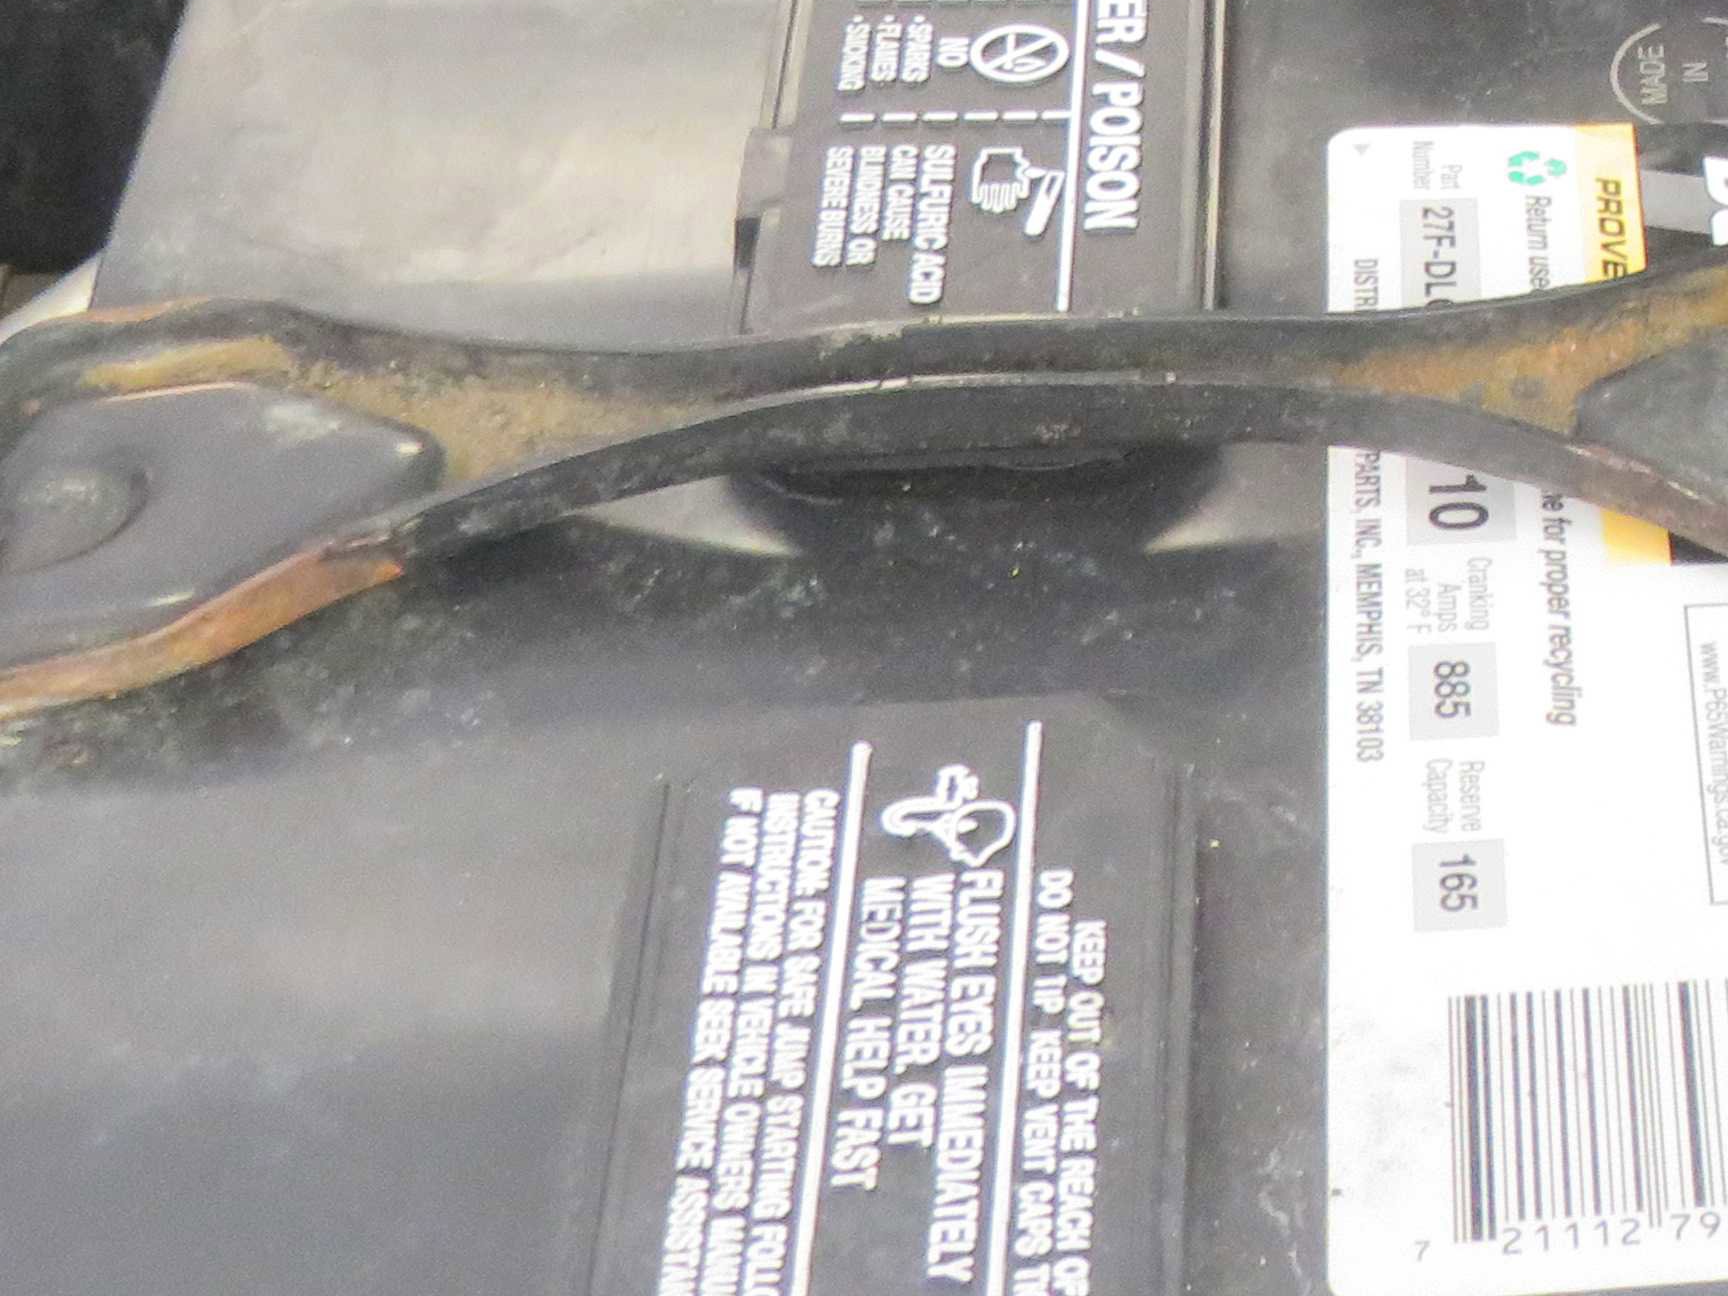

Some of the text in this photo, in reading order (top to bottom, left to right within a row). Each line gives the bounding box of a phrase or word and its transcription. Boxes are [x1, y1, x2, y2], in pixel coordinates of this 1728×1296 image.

[937, 37, 970, 67] NO
[1639, 42, 1668, 106] MADE
[1683, 61, 1709, 83] IN
[1084, 81, 1144, 231] POISON
[1412, 140, 1434, 191] Number
[1441, 164, 1463, 190] Part
[812, 145, 854, 267] SEVERE BURNS
[845, 145, 886, 266] BLINDNESS OR
[881, 144, 918, 241] CAN CAUSE
[908, 144, 956, 305] SULFURIC ACID
[1525, 194, 1553, 293] Return use
[1542, 516, 1572, 546] for
[1405, 567, 1426, 584] at
[1432, 581, 1462, 633] Amps
[1464, 556, 1493, 631] Cranking
[1538, 550, 1571, 620] proper
[1351, 563, 1383, 662] MEMPHIS,
[1356, 667, 1384, 694] TN
[1432, 660, 1472, 720] 885
[1544, 624, 1583, 727] recycling
[1356, 701, 1384, 762] 38103
[728, 787, 764, 813] IF
[1421, 757, 1454, 834] Capacity
[1458, 759, 1486, 832] Reserve
[719, 815, 760, 868] NOT
[745, 791, 800, 962] INSTRUCTIONS
[1037, 869, 1074, 909] DO
[1438, 853, 1479, 913] 165
[701, 870, 754, 996] AVAILABLE
[786, 900, 827, 953] FOR
[1034, 912, 1070, 965] NOT
[1072, 919, 1107, 986] KEEP
[742, 964, 780, 994] IN
[777, 954, 821, 1018] SAFE
[886, 872, 956, 1149] WITH WATER. GET
[1032, 975, 1067, 1015] TIP
[691, 996, 735, 1064] SEEK
[726, 996, 776, 1099] VEHICLE
[830, 875, 907, 1193] MEDICAL HELP FAST
[1067, 990, 1105, 1043] OUT
[771, 1022, 812, 1089] JUMP
[927, 868, 1004, 1285] FLUSH EYES IMMEDIATELY
[1026, 1029, 1063, 1100] KEEP
[1063, 1050, 1100, 1091] OF
[675, 1066, 725, 1171] SERVICE
[1020, 1104, 1059, 1175] VENT
[1059, 1096, 1099, 1153] THE
[711, 1101, 762, 1212] OWNERS
[751, 1093, 804, 1221] STARTING
[1013, 1181, 1054, 1258] CAPS
[1055, 1157, 1096, 1253] REACH
[1414, 1239, 1432, 1262] 7
[1501, 1218, 1643, 1256] 21112
